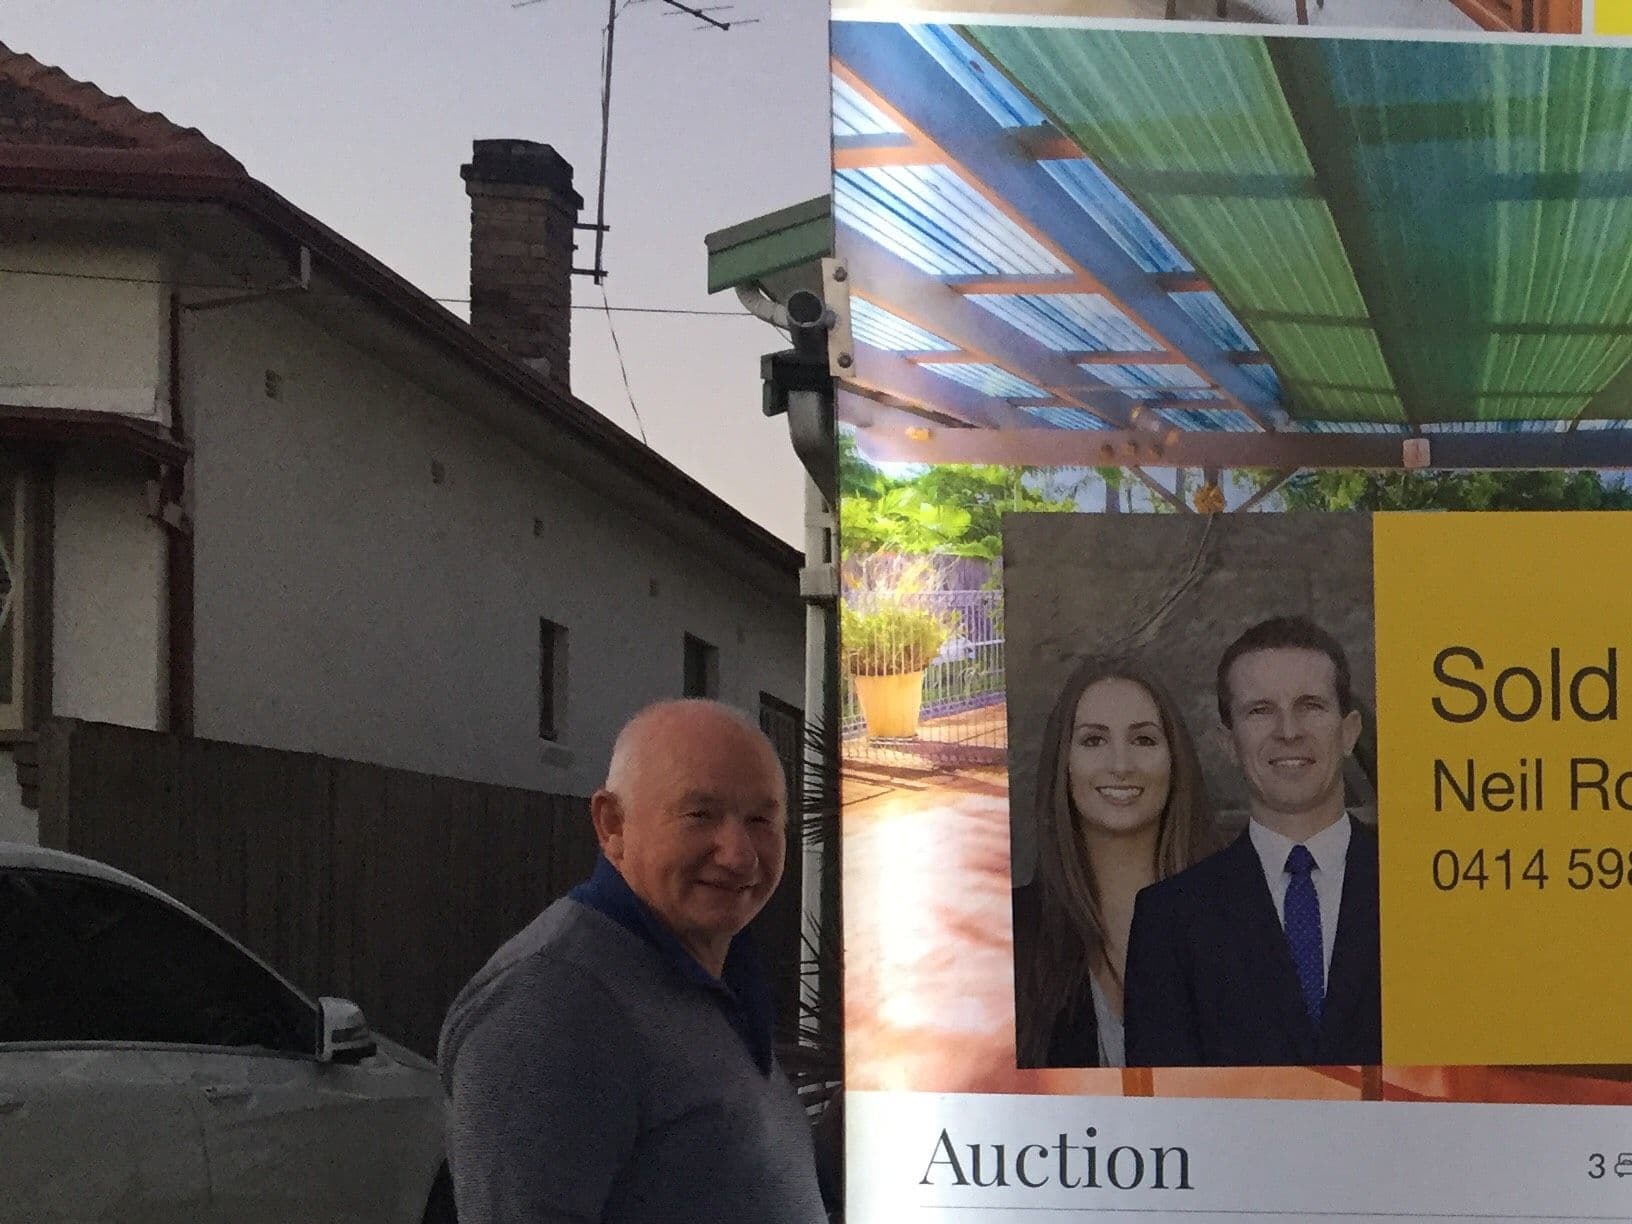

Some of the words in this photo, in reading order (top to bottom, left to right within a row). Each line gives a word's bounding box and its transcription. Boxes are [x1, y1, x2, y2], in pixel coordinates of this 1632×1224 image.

[1431, 645, 1618, 724] Sold
[1433, 757, 1543, 813] Neil
[1432, 848, 1550, 892] 0414
[918, 1125, 1196, 1191] Auction
[1587, 1152, 1606, 1180] 3
